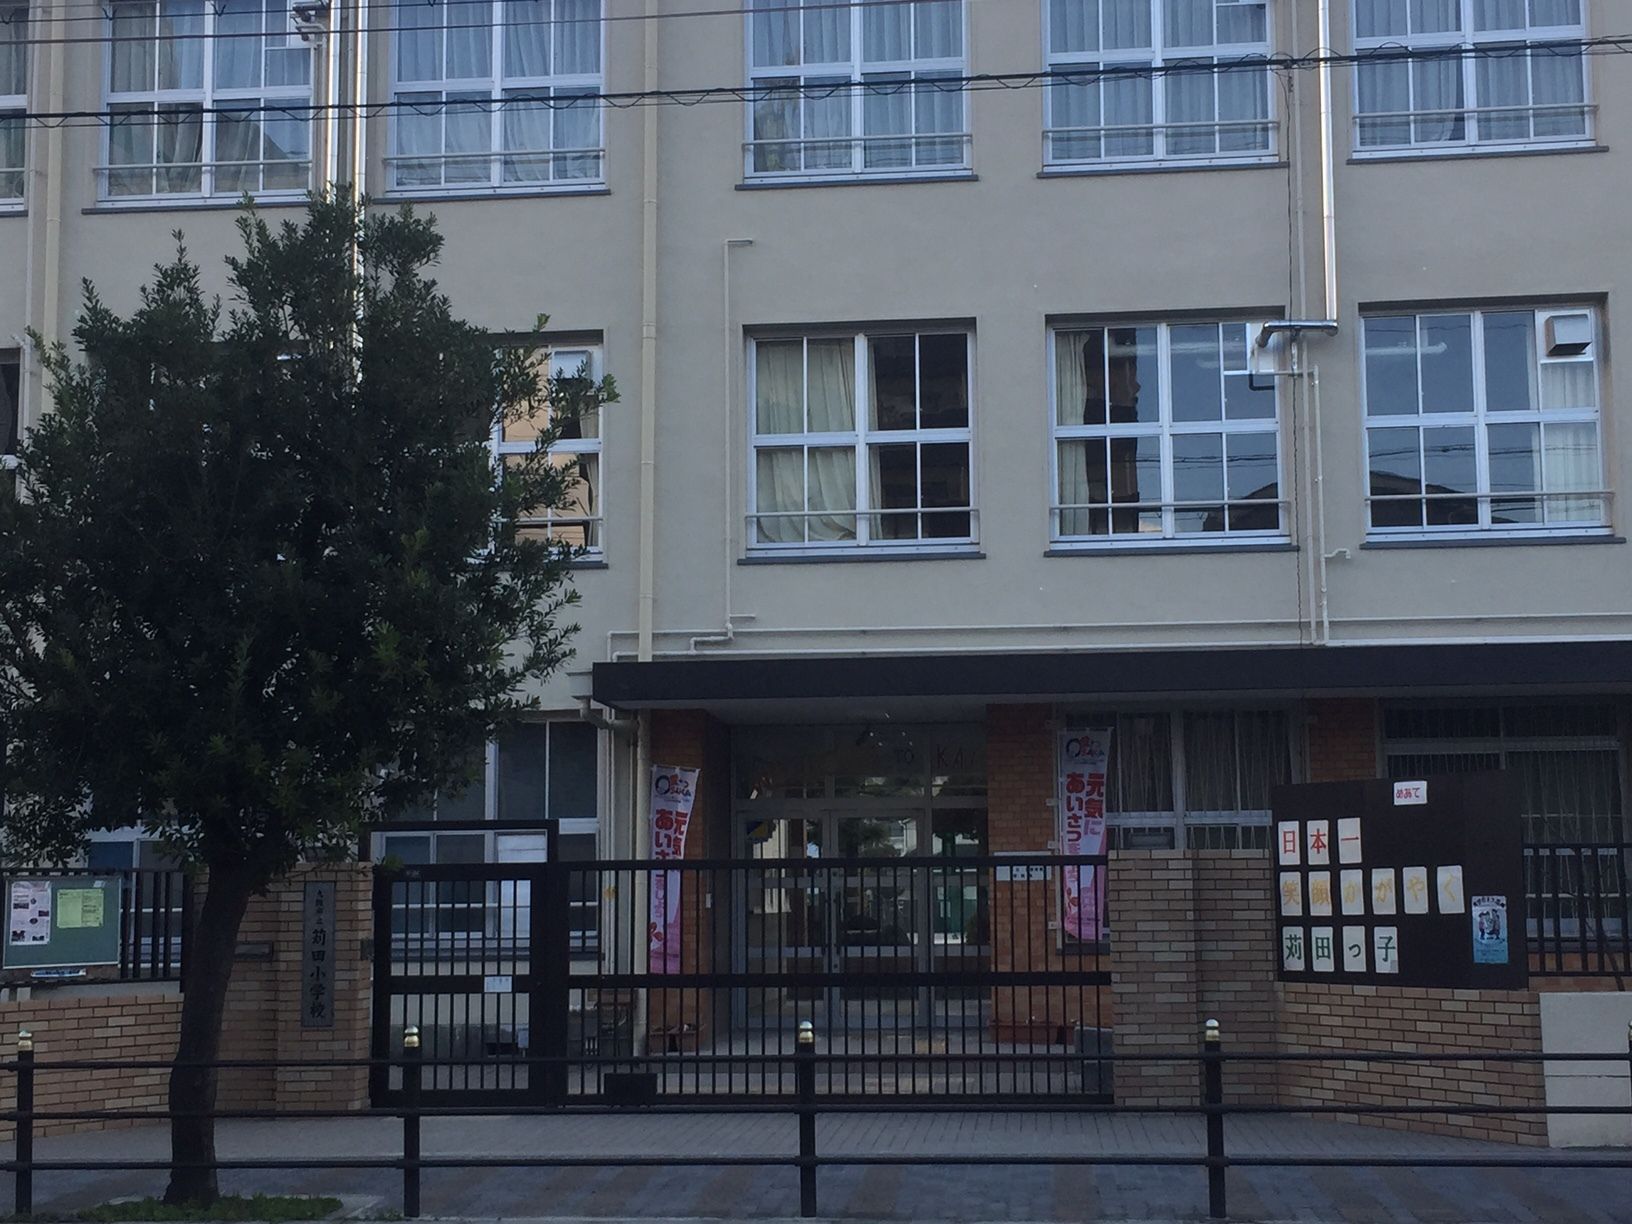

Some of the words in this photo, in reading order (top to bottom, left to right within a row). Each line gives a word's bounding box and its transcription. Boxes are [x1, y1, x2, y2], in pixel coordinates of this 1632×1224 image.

[1084, 772, 1104, 835] 元気に
[1282, 827, 1360, 855] 日本一
[1281, 873, 1458, 906] 笑顔かがやく
[1284, 933, 1397, 963] 苅田っ子
